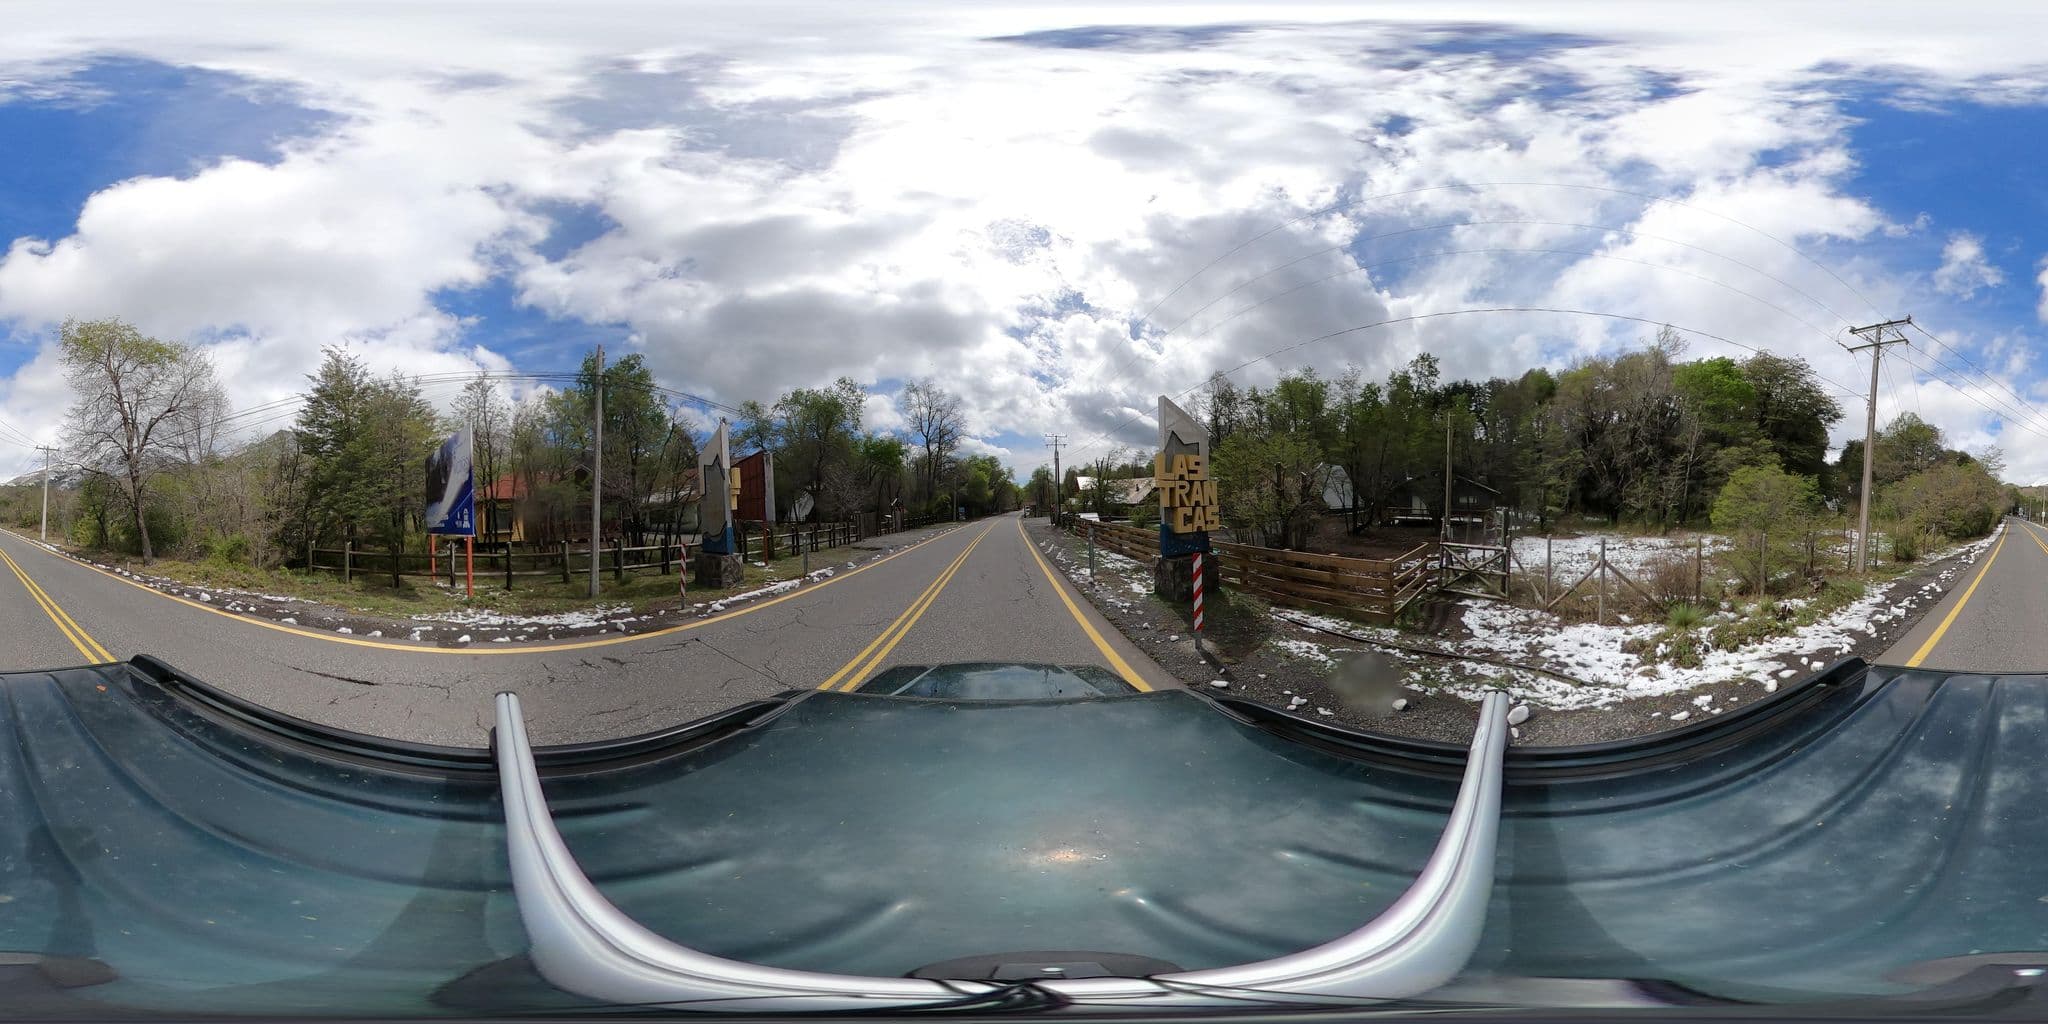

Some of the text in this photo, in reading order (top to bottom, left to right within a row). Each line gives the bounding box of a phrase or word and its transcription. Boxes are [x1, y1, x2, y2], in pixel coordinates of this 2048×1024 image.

[1154, 452, 1200, 480] LAS
[1155, 480, 1217, 507] TRAN
[1173, 505, 1219, 533] CAS
